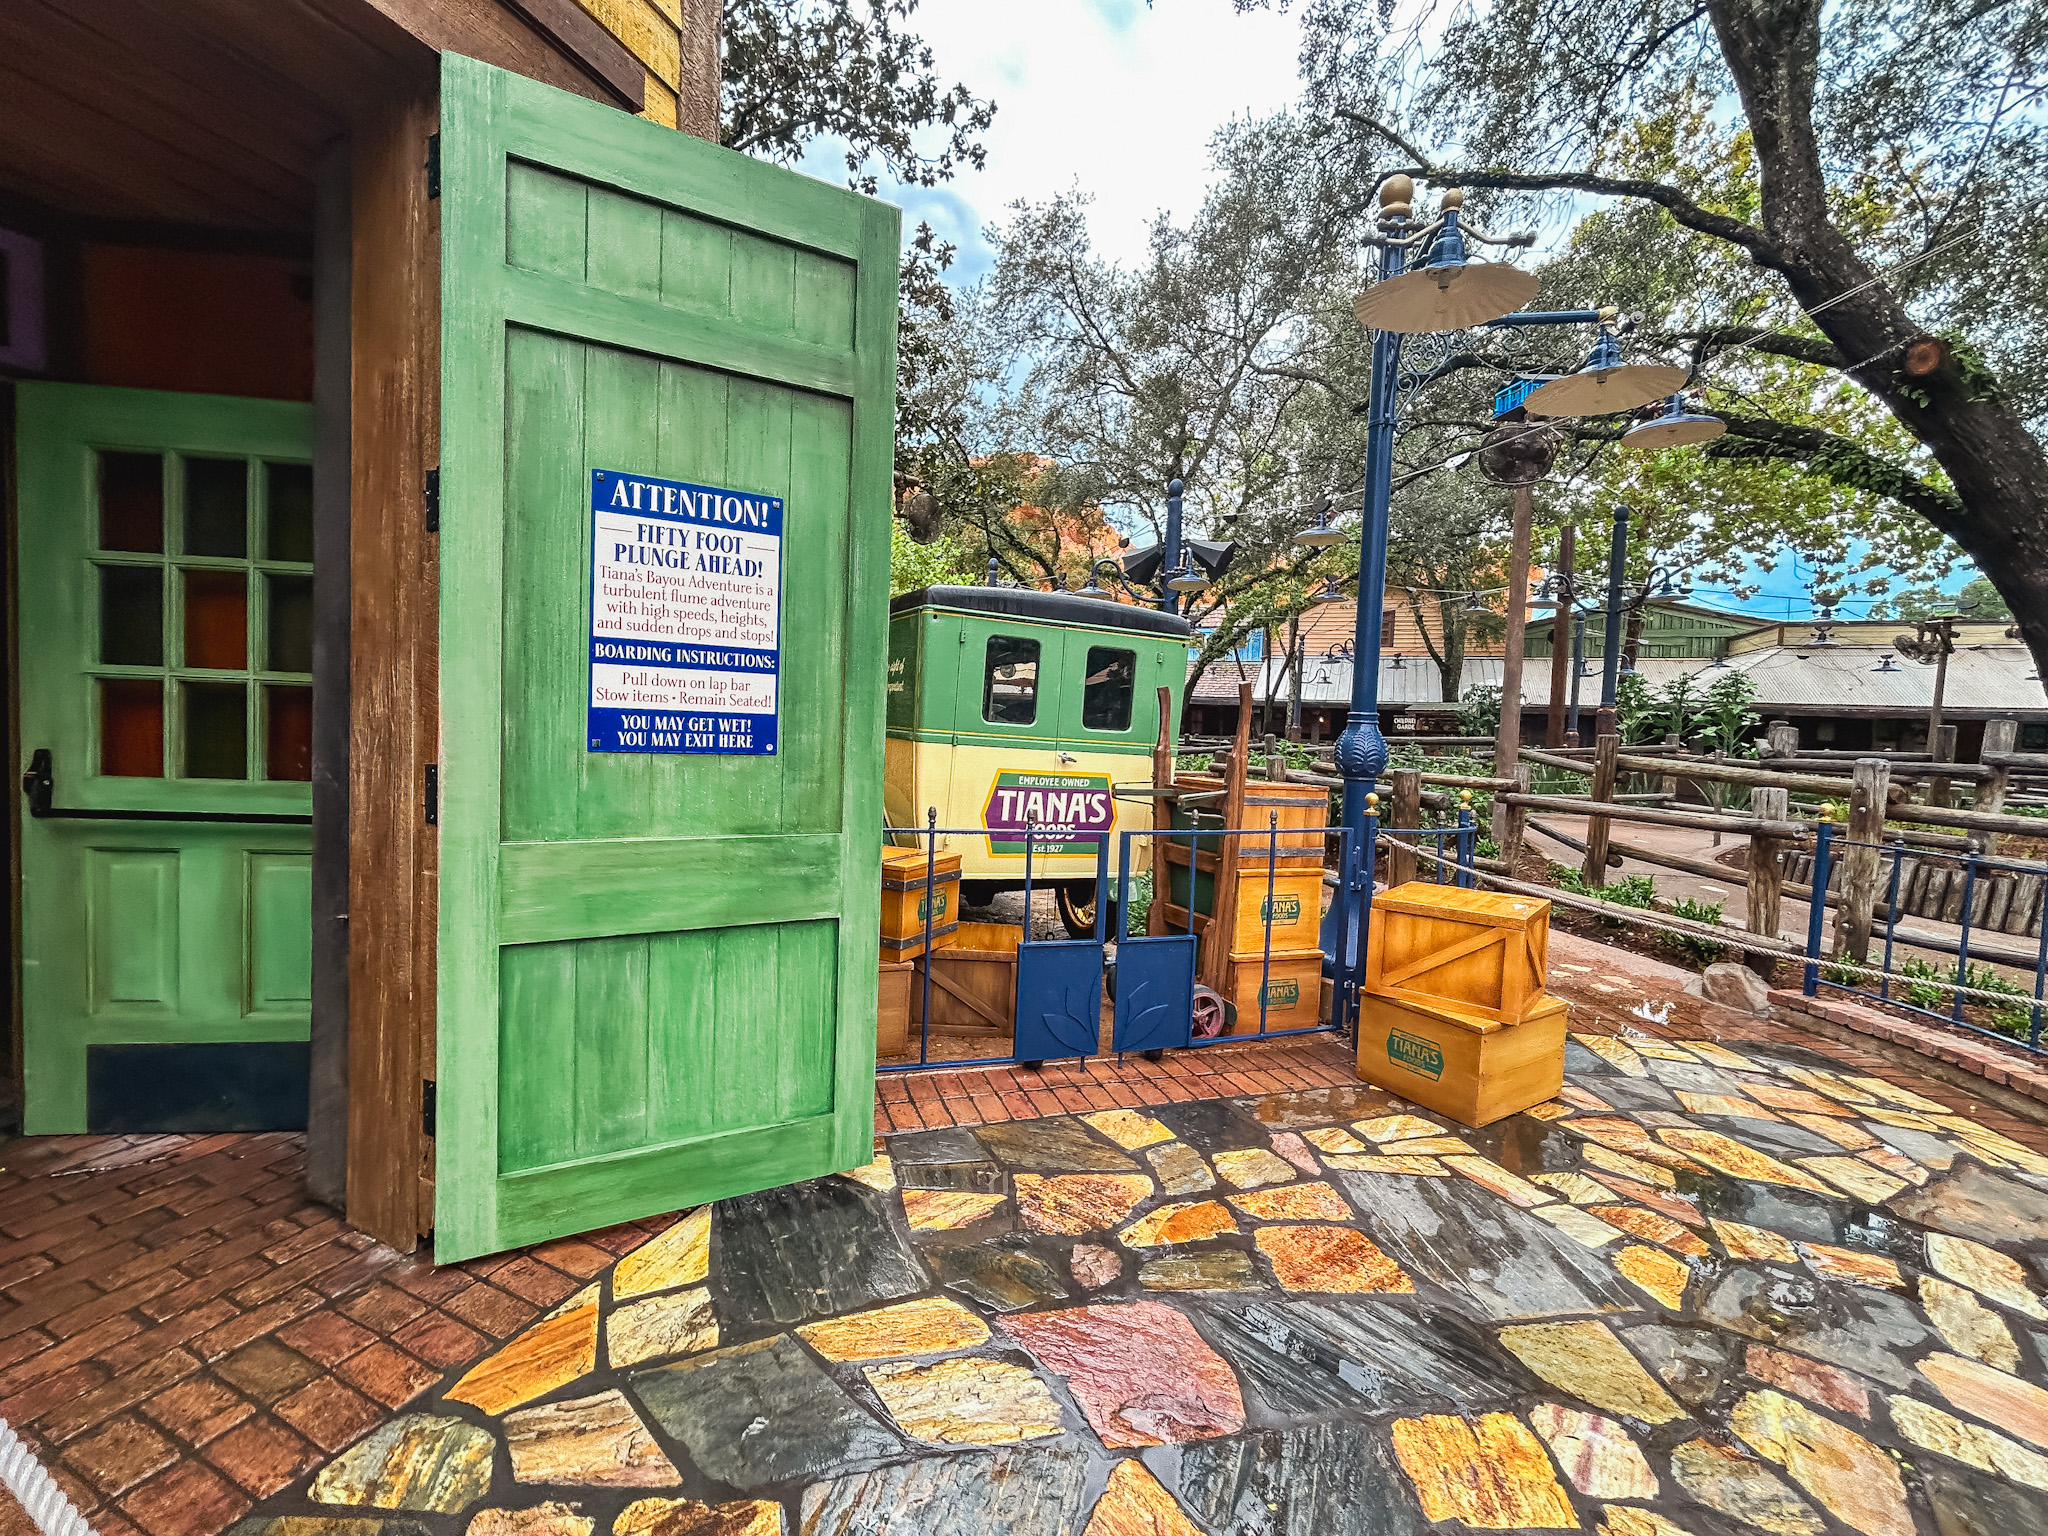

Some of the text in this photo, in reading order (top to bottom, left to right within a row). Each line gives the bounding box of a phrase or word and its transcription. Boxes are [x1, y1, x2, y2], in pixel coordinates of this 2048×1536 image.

[610, 479, 769, 528] ATTENTION!
[636, 523, 743, 555] FIFTY FOOT
[614, 543, 763, 578] PLUNGE AHEAD!
[599, 565, 773, 596] Tiana's Bayou Adventure is a
[603, 583, 771, 611] turbulent flume adventure
[607, 600, 767, 628] with high speeds, heights,
[597, 617, 774, 645] and sudden drops and stops!
[594, 643, 775, 669] BOARDING INSTRUCTIONS:
[622, 672, 751, 693] Pull down on lap bar
[596, 687, 772, 708] Stow items Remain Seated!
[621, 714, 752, 733] YOU MAY GET WET!
[617, 731, 754, 749] YOU MAY EXIT HERE
[1018, 776, 1090, 787] EMPLOYEE OWNED
[997, 789, 1107, 824] TIANA'S
[1267, 985, 1296, 999] IANA'S
[1392, 1036, 1439, 1065] TIANA'S
[1402, 1054, 1426, 1068] FOODS
